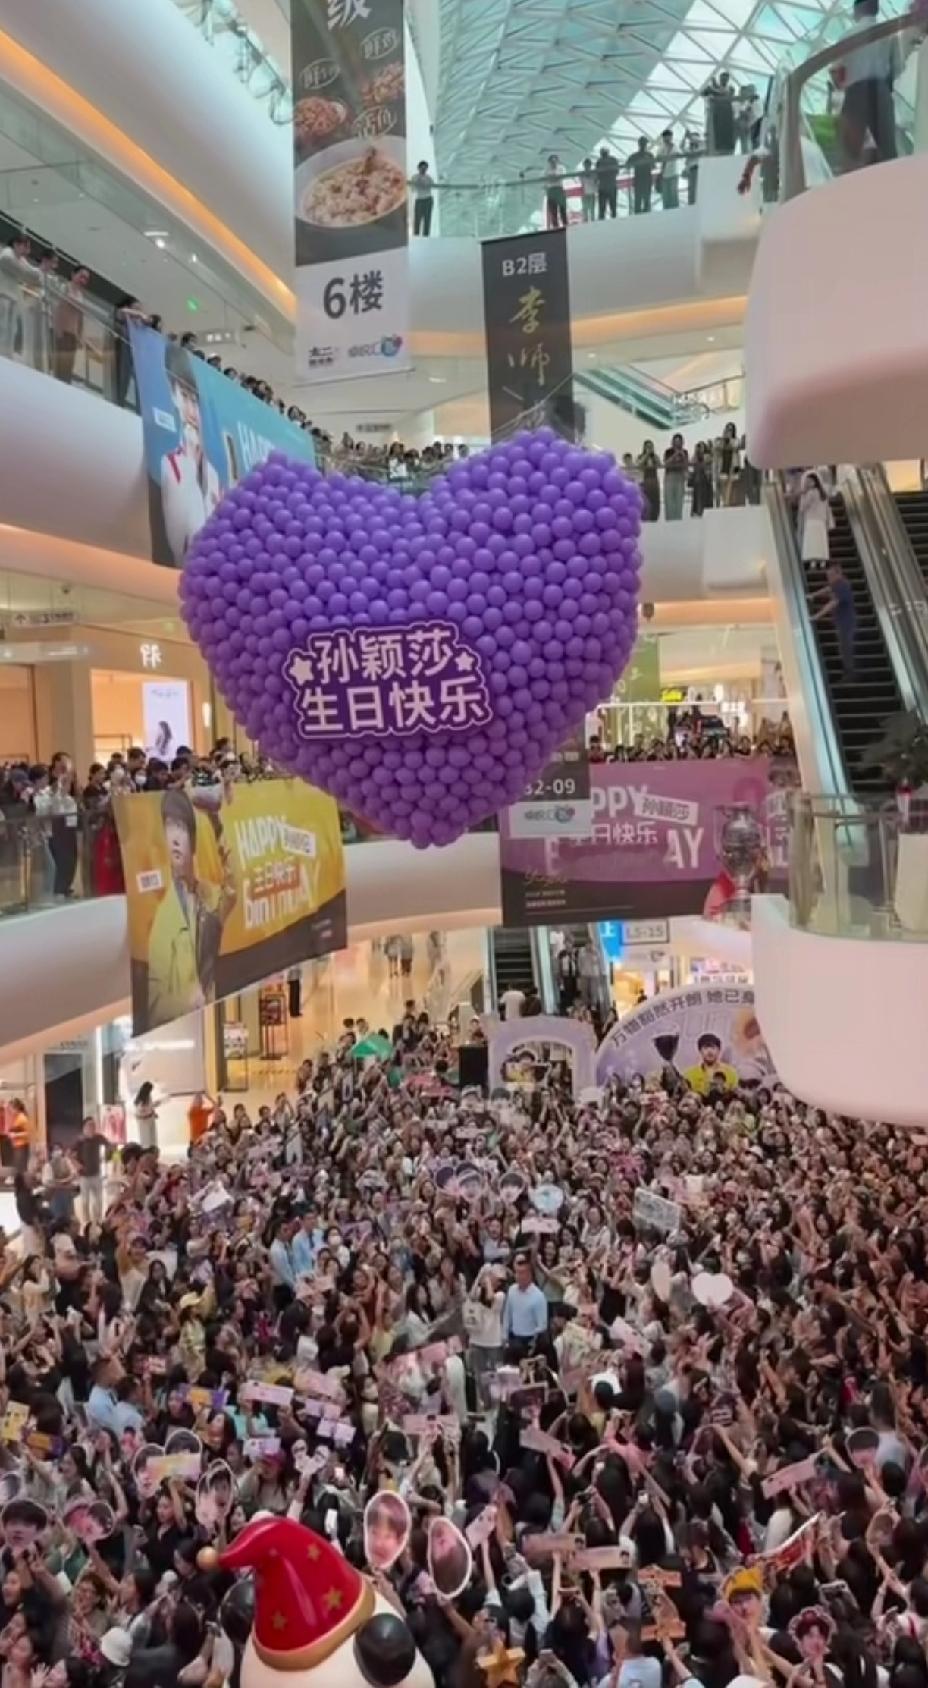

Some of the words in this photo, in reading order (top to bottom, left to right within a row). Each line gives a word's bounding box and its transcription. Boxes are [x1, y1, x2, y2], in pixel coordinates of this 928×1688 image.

[502, 253, 547, 276] B2层
[323, 270, 384, 319] 6楼
[314, 629, 453, 684] 孙颖莎
[302, 675, 484, 731] 生日快乐
